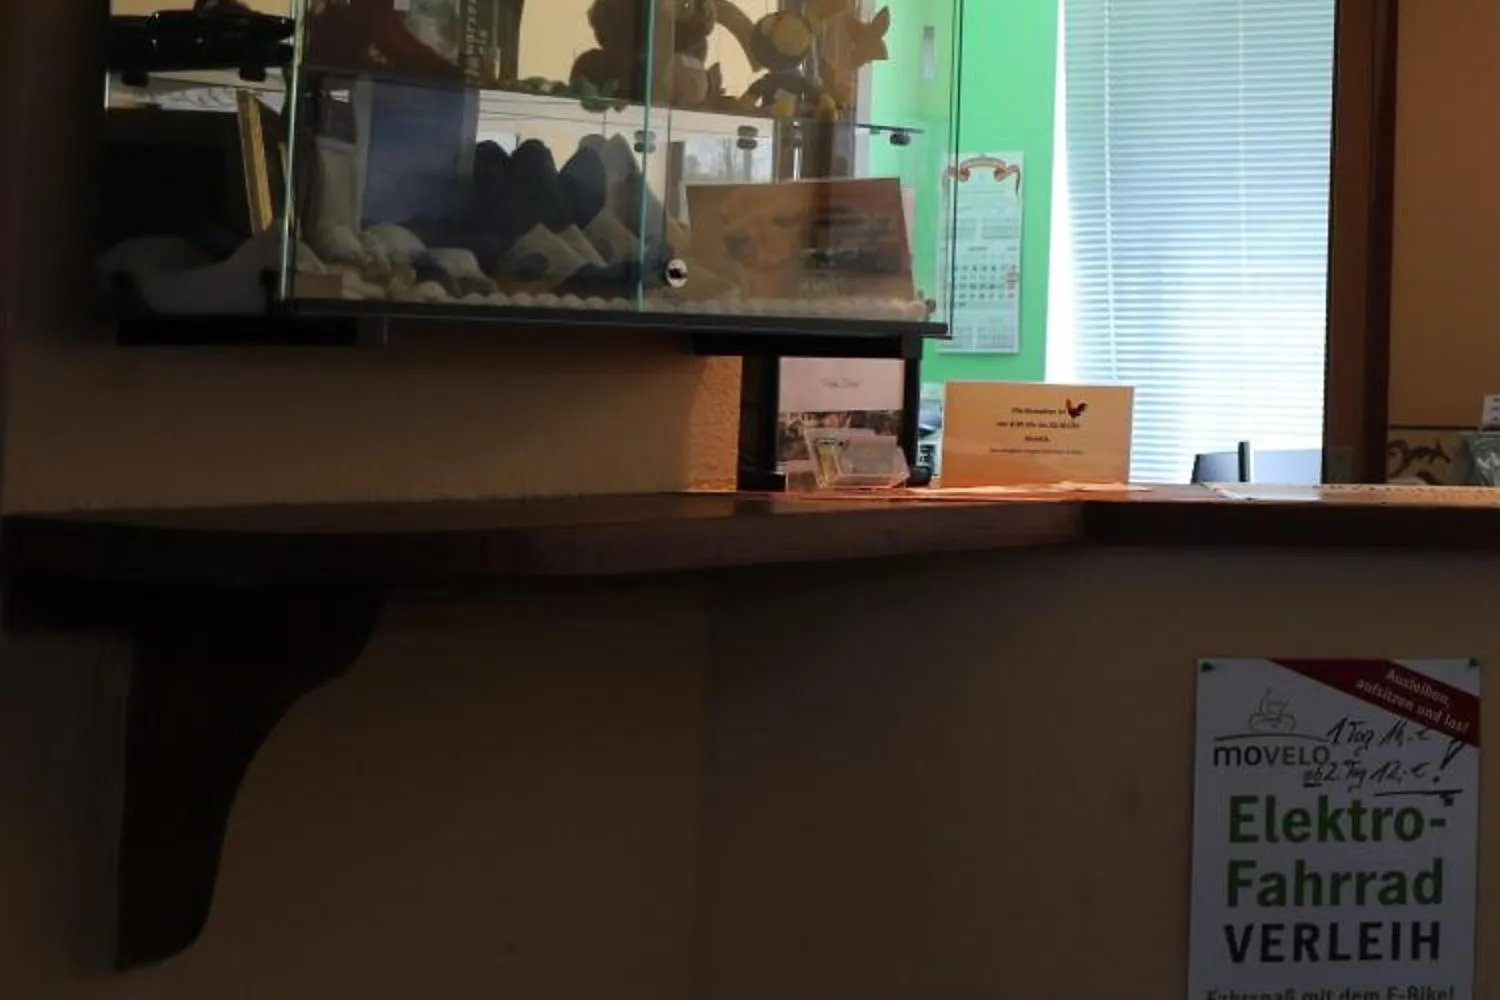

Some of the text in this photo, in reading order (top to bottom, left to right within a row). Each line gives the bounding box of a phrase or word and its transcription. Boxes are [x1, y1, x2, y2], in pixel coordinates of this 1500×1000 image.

[1417, 705, 1441, 724] und
[1228, 795, 1447, 844] Elektro-
[1227, 857, 1444, 907] Fahrrad
[1223, 921, 1441, 963] VERLEIH
